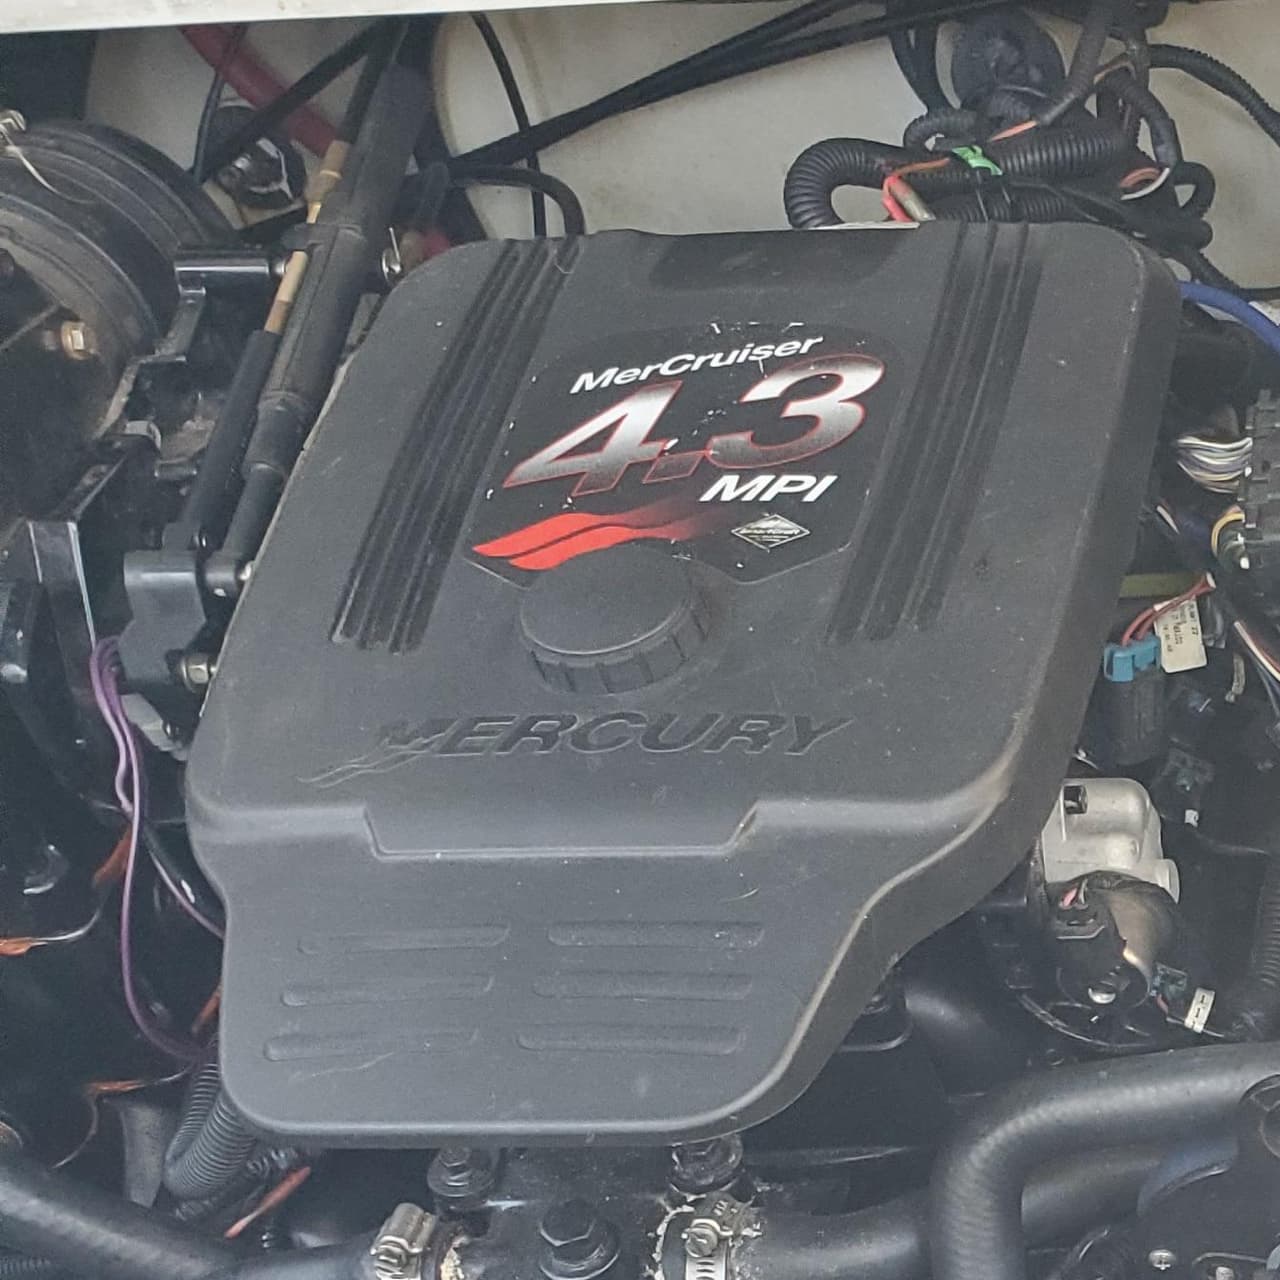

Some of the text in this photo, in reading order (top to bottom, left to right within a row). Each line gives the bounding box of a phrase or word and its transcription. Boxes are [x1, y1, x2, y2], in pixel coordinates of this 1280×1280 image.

[569, 336, 824, 394] MerCruiser
[503, 353, 886, 497] 4.3
[699, 474, 838, 503] MPI
[360, 711, 854, 762] MERCURY
